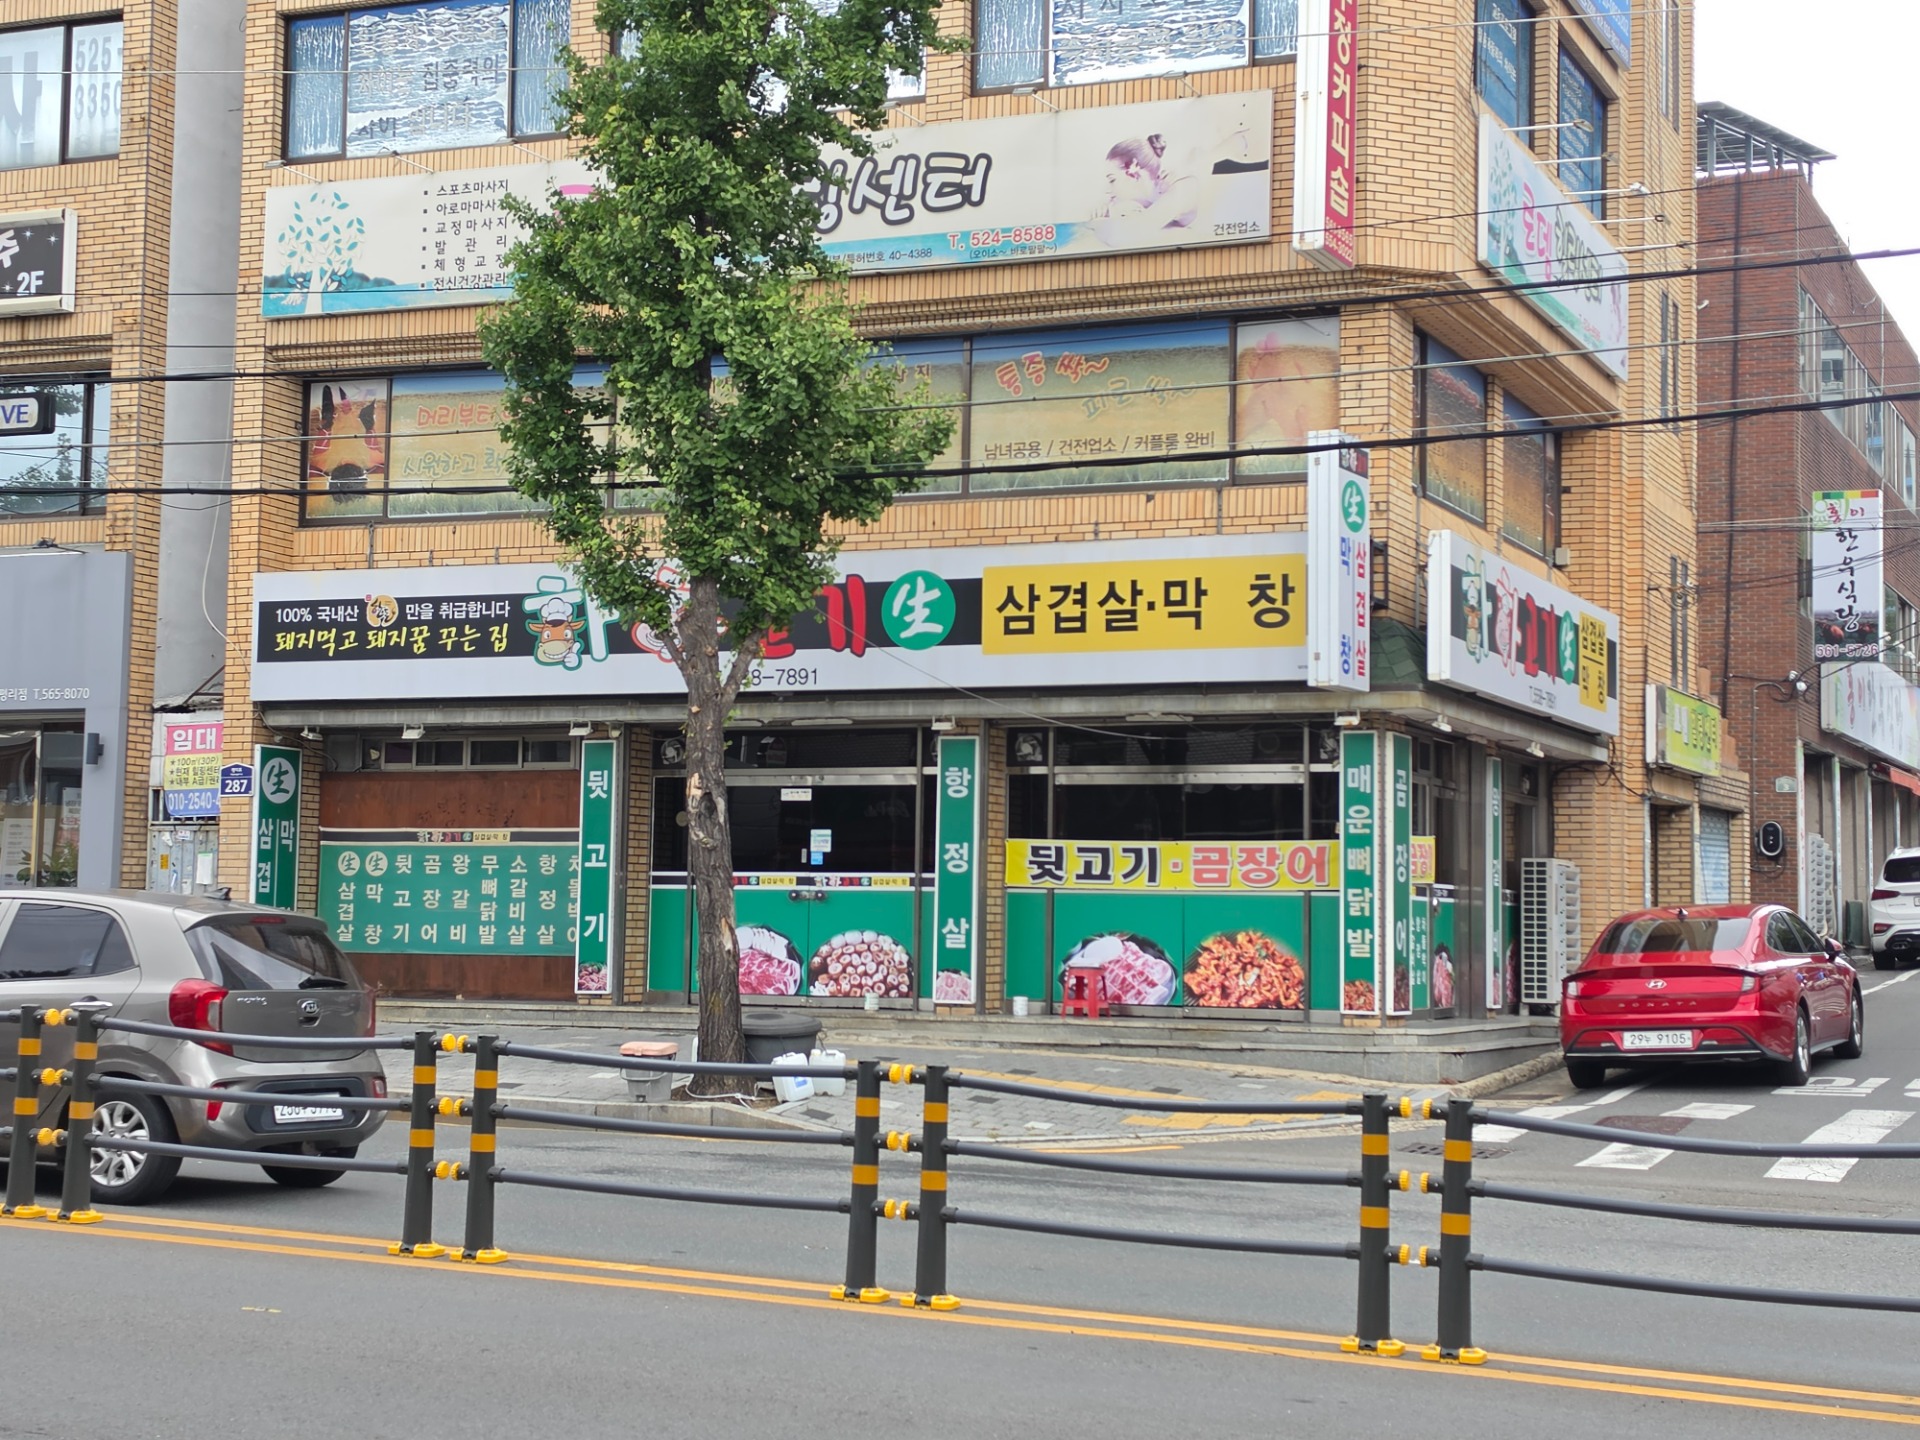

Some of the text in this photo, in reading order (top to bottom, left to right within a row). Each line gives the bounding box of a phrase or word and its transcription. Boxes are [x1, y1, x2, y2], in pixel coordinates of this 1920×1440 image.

[436, 178, 509, 197] 스포츠마사지
[971, 226, 1056, 247] 524-8588
[1212, 220, 1261, 236] 건전업소
[889, 248, 933, 260] 40-4388
[16, 270, 44, 296] 2F
[434, 272, 506, 292] 전신건강관리
[995, 351, 1046, 398] 통증
[417, 402, 496, 429] 머리부터
[984, 440, 1042, 461] 남녀공용
[1058, 437, 1118, 457] 건전업소
[1184, 429, 1216, 451] 완비
[403, 451, 477, 478] 시원하고
[275, 606, 312, 623] 100%
[316, 604, 359, 623] 국내산
[405, 602, 436, 620] 만을
[438, 600, 511, 621] 취급합니다
[273, 621, 510, 657] 돼지먹고 돼지꿈 꾸는 집
[33, 687, 90, 701] T.565-8070
[173, 728, 217, 752] 임대
[225, 779, 248, 793] 287
[940, 766, 972, 950] 항정살
[1617, 1000, 1698, 1009] SONATA
[1657, 1033, 1687, 1044] 9105
